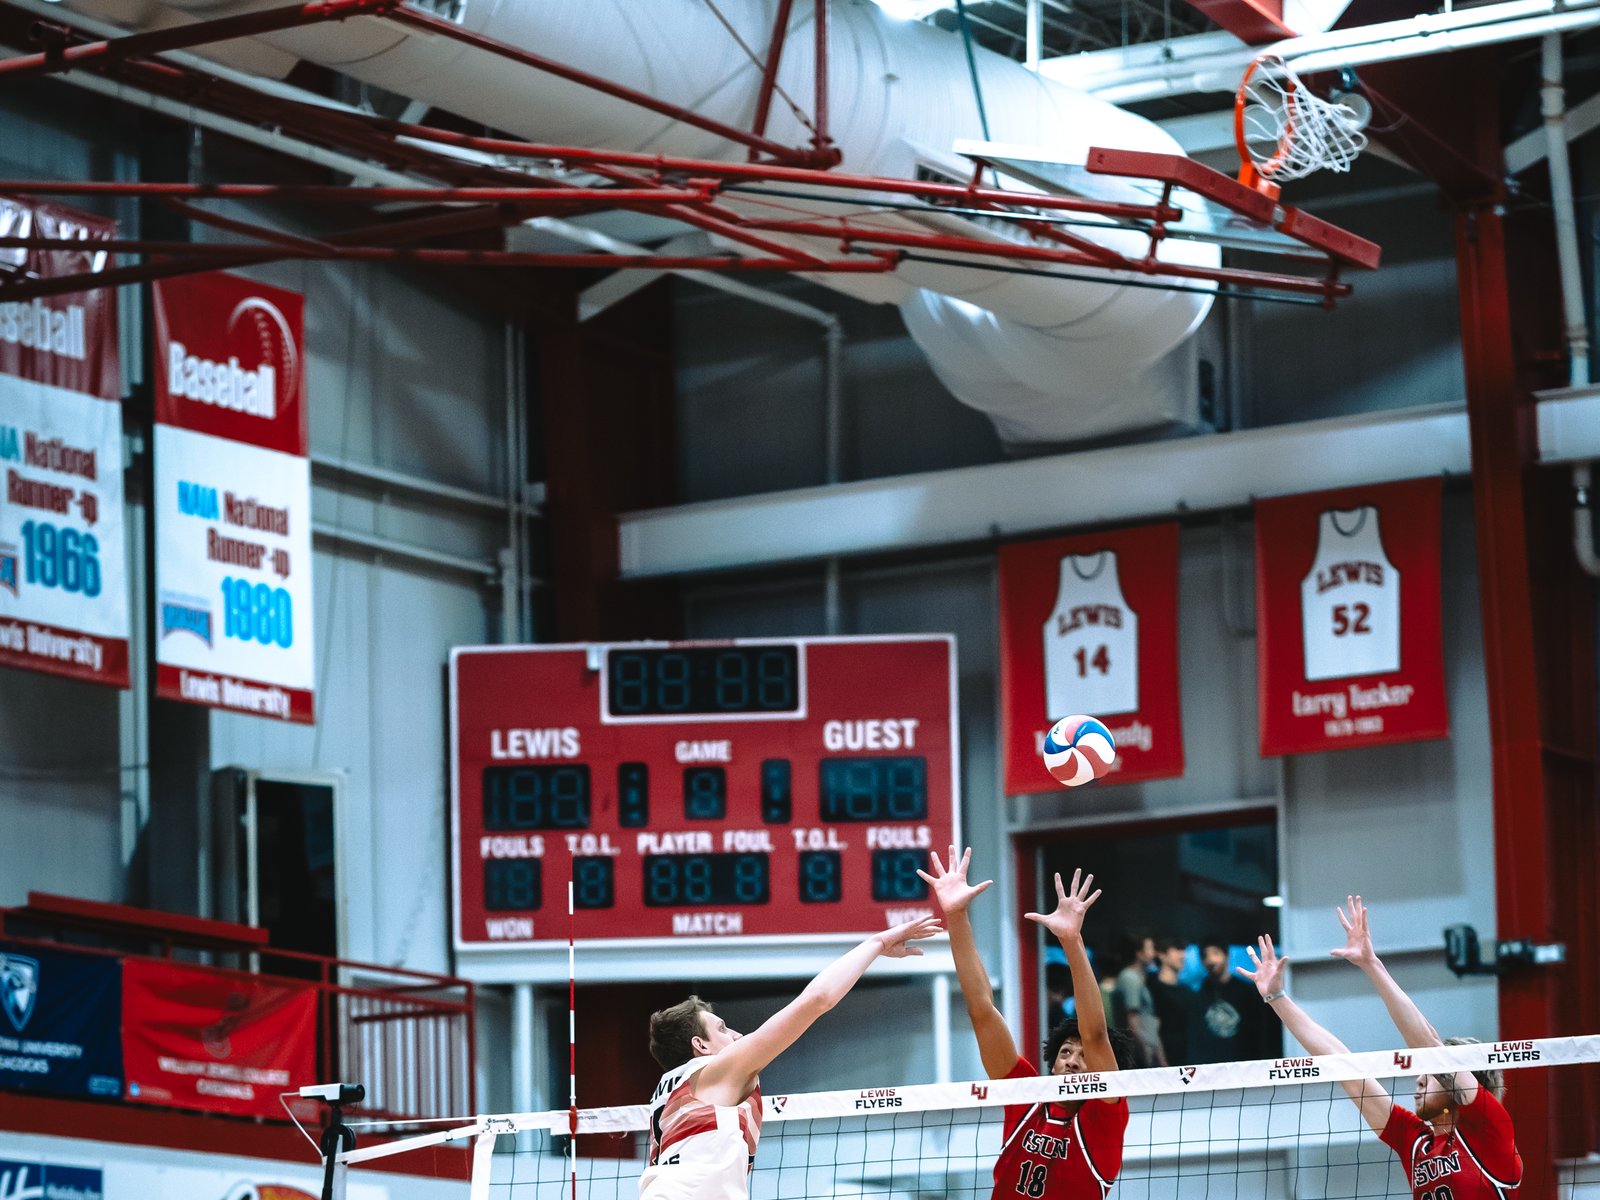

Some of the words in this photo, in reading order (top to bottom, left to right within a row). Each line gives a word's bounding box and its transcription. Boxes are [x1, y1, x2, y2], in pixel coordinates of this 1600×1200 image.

[0, 299, 86, 361] seball
[168, 341, 276, 419] Baseball
[24, 430, 97, 482] National
[223, 491, 290, 537] National
[21, 519, 102, 598] 1966
[1315, 560, 1385, 593] LEWIS
[221, 575, 293, 649] 1980
[1057, 604, 1124, 636] LEWIS
[1331, 602, 1371, 637] 52
[1074, 644, 1110, 678] 14
[1292, 690, 1347, 719] Larry
[490, 727, 581, 760] LEWIS
[823, 718, 919, 752] GUEST
[674, 739, 732, 763] GAME
[480, 835, 545, 859] FOULS
[636, 831, 714, 855] PLAYER
[722, 829, 775, 853] FOUL
[866, 825, 932, 849] FOULS
[485, 917, 534, 939] WON
[672, 912, 744, 936] MATCH
[1488, 1050, 1540, 1064] FLYERS
[1493, 1041, 1533, 1052] LEWIS
[1063, 1073, 1101, 1084] LEWIS
[1269, 1067, 1319, 1080] FLYERS
[1274, 1058, 1313, 1069] LEWIS
[855, 1097, 902, 1110] FLYERS
[860, 1088, 896, 1099] LEWIS
[1058, 1082, 1107, 1095] FLYERS
[1022, 1128, 1071, 1160] CSUN
[1015, 1159, 1048, 1199] 18
[1414, 1150, 1462, 1188] SUN
